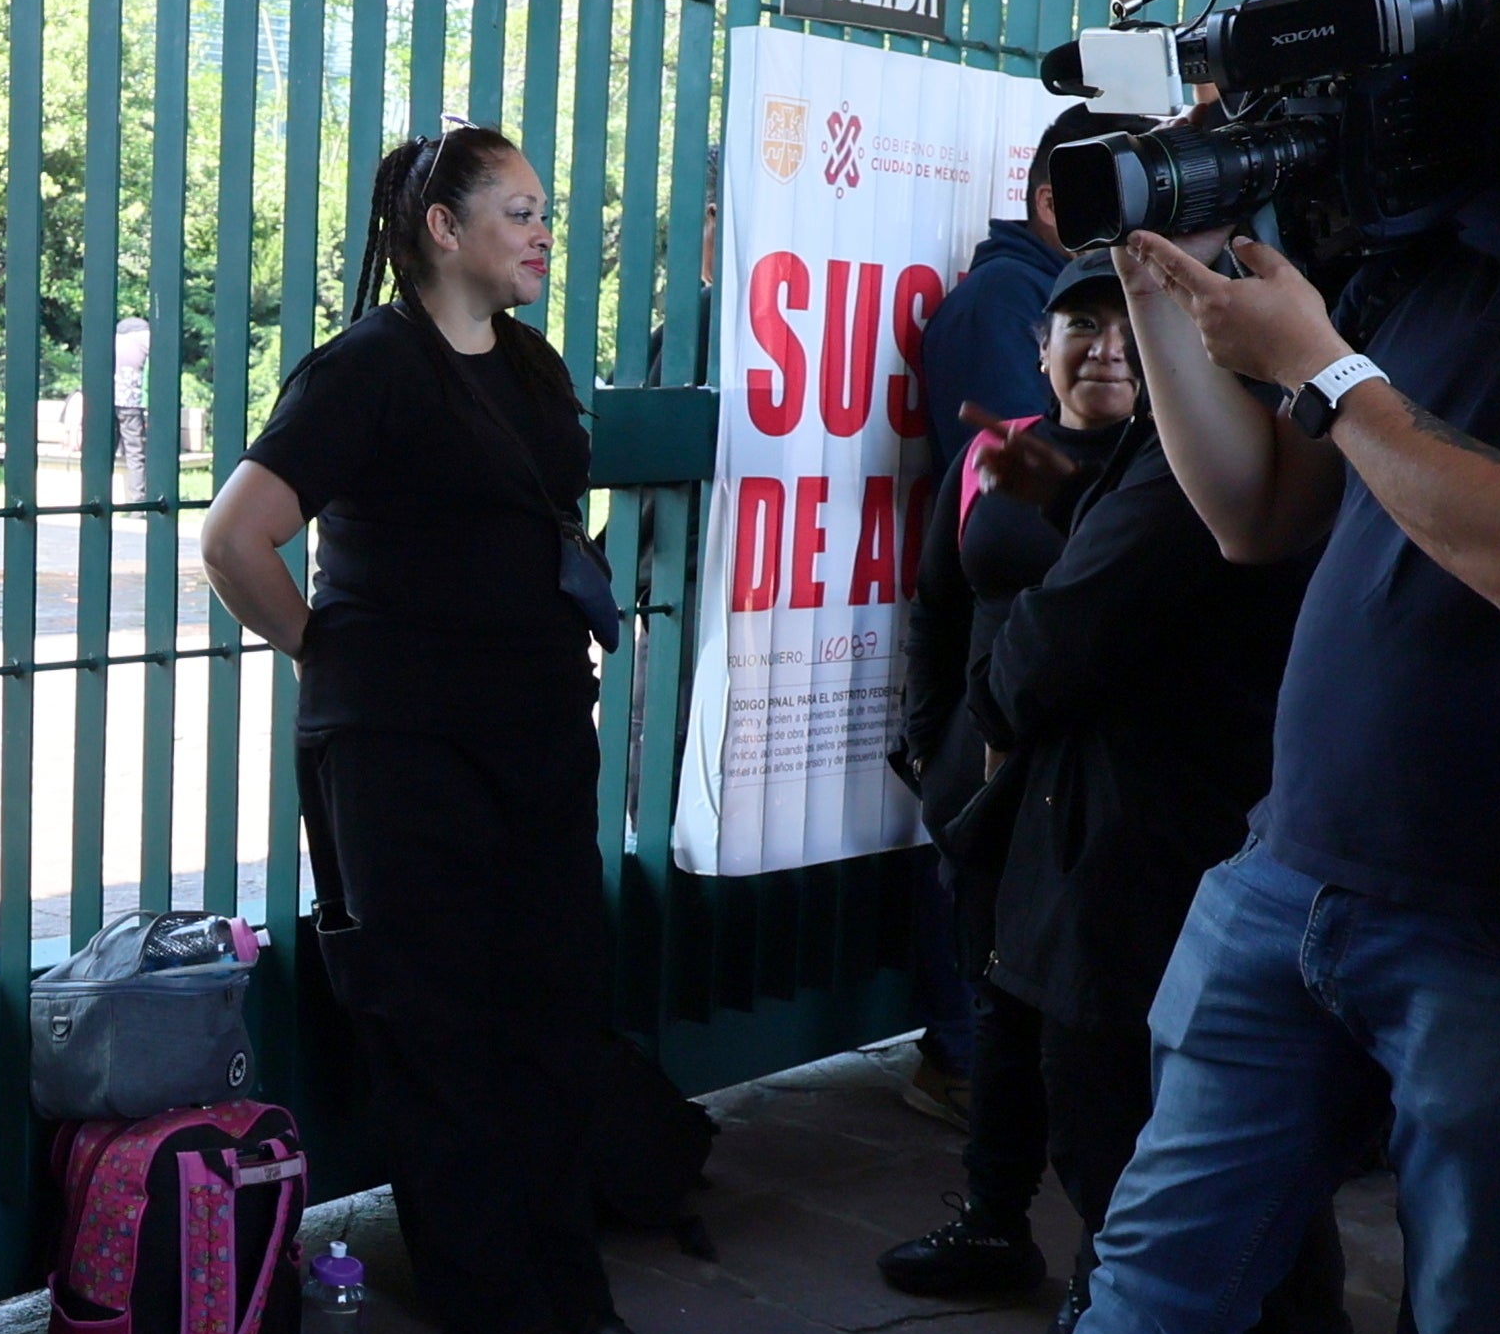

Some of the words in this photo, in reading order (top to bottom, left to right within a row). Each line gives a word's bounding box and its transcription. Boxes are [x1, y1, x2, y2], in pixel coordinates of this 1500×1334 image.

[1271, 25, 1335, 46] XDCAM
[872, 135, 935, 158] GOBIERNO
[940, 146, 955, 161] DE
[958, 149, 969, 163] LA
[1007, 144, 1038, 160] INST
[871, 157, 913, 175] CIUDAD
[915, 163, 931, 178] DE
[933, 163, 971, 184] MÉXICO
[747, 250, 970, 438] SUS
[732, 476, 829, 612] DE
[819, 631, 878, 664] 16087
[797, 694, 817, 707] PARA
[820, 693, 829, 704] EL
